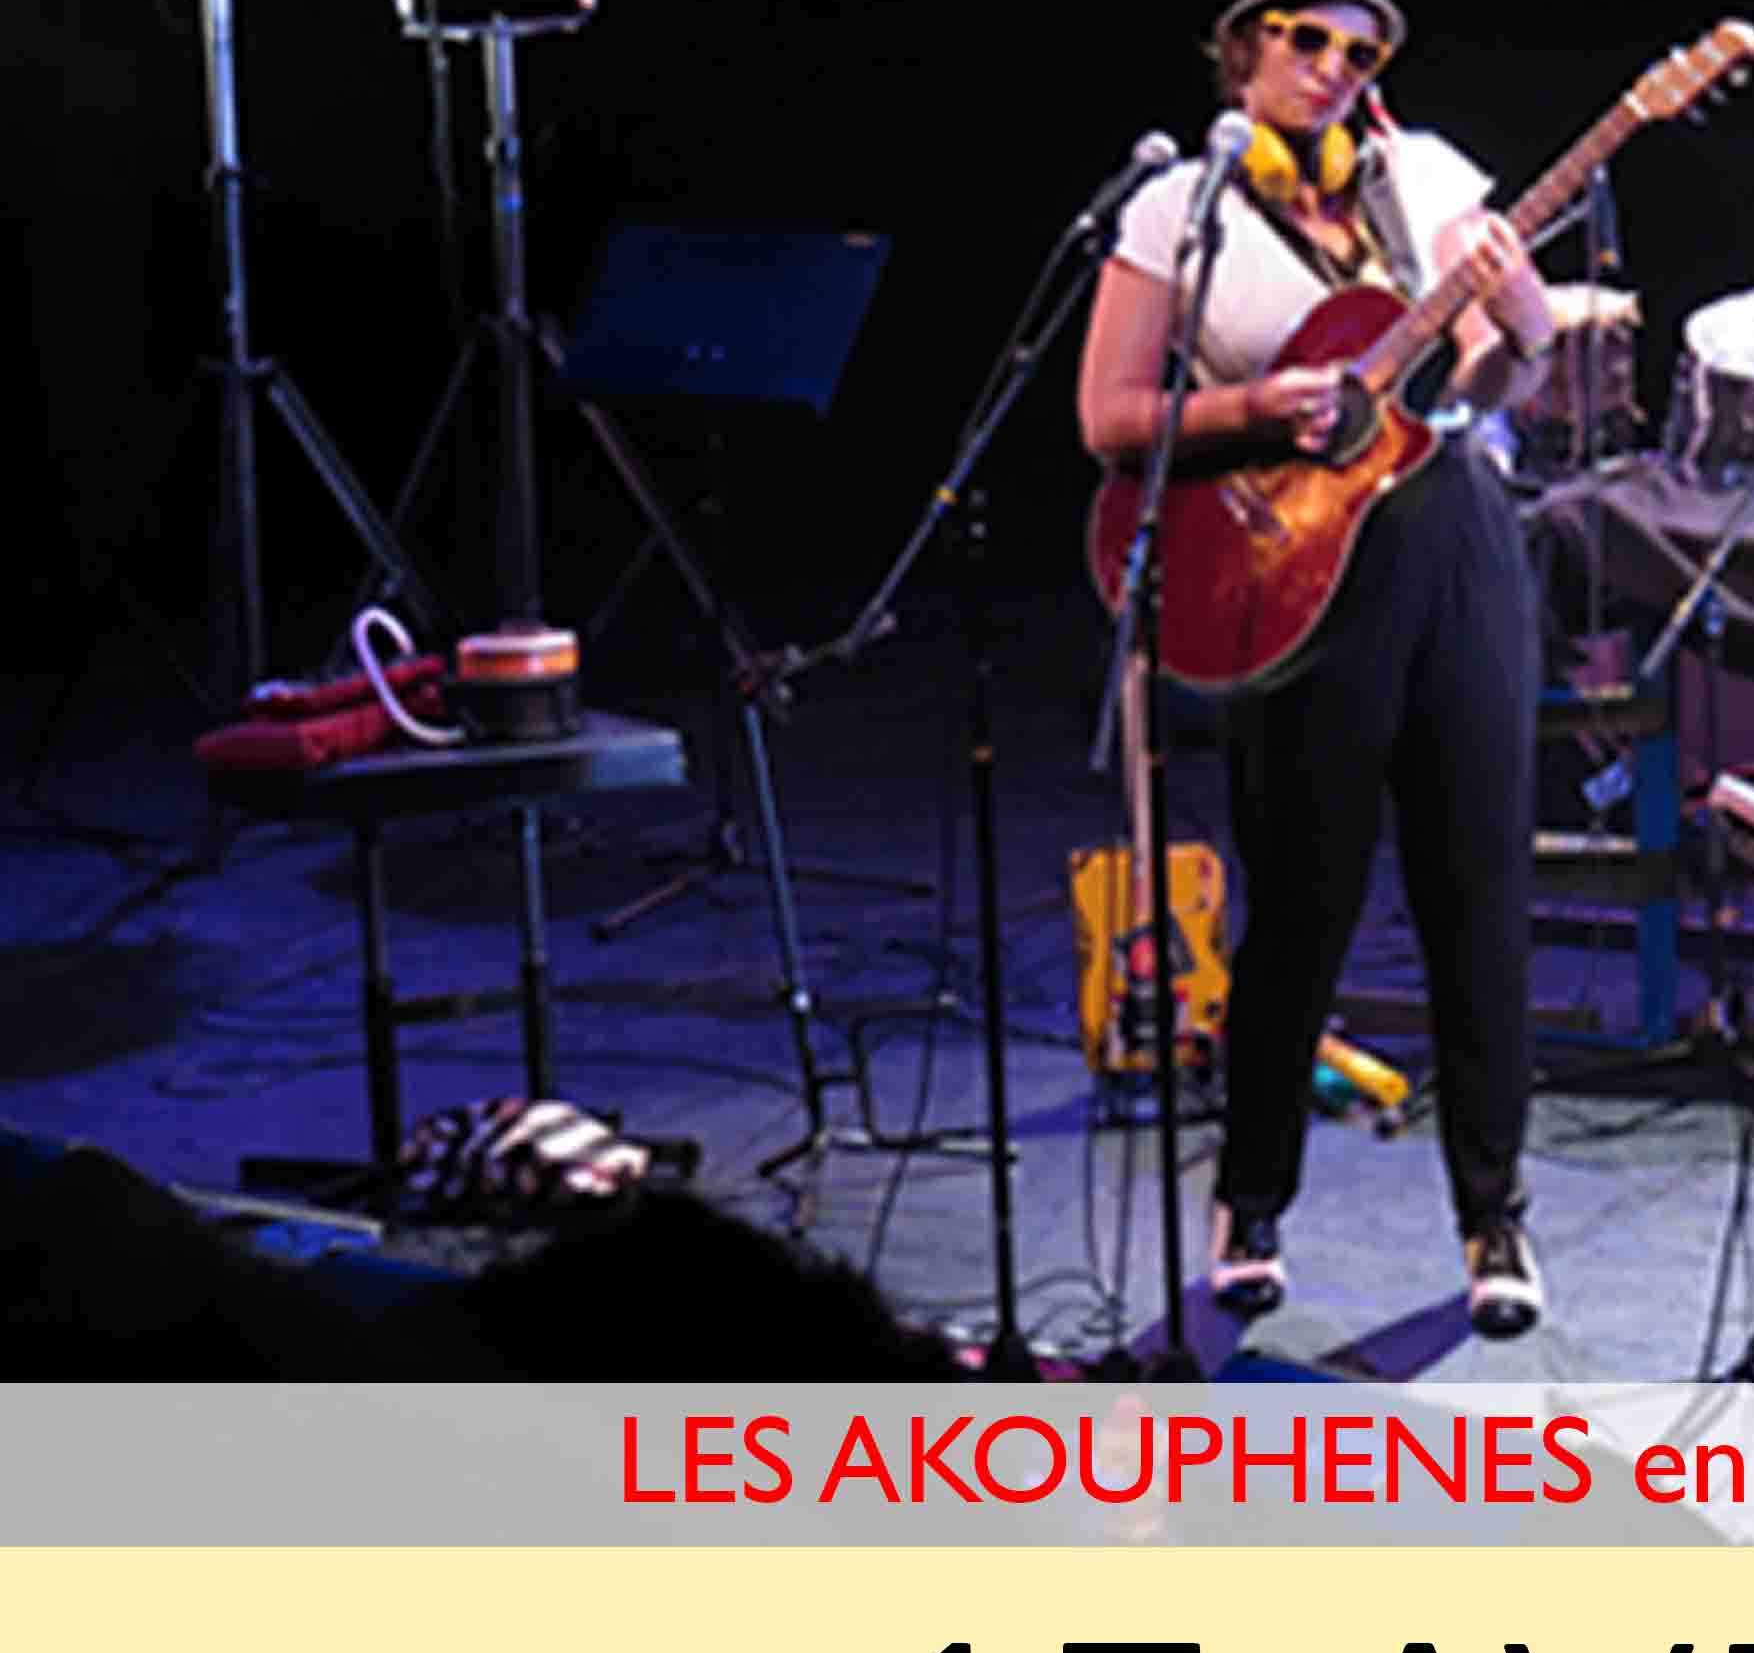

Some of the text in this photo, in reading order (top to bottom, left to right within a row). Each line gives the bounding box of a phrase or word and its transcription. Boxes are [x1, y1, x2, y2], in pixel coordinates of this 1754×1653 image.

[623, 1415, 793, 1504] LES
[818, 1415, 1592, 1504] AKOUPHENES
[1634, 1444, 1745, 1504] en
